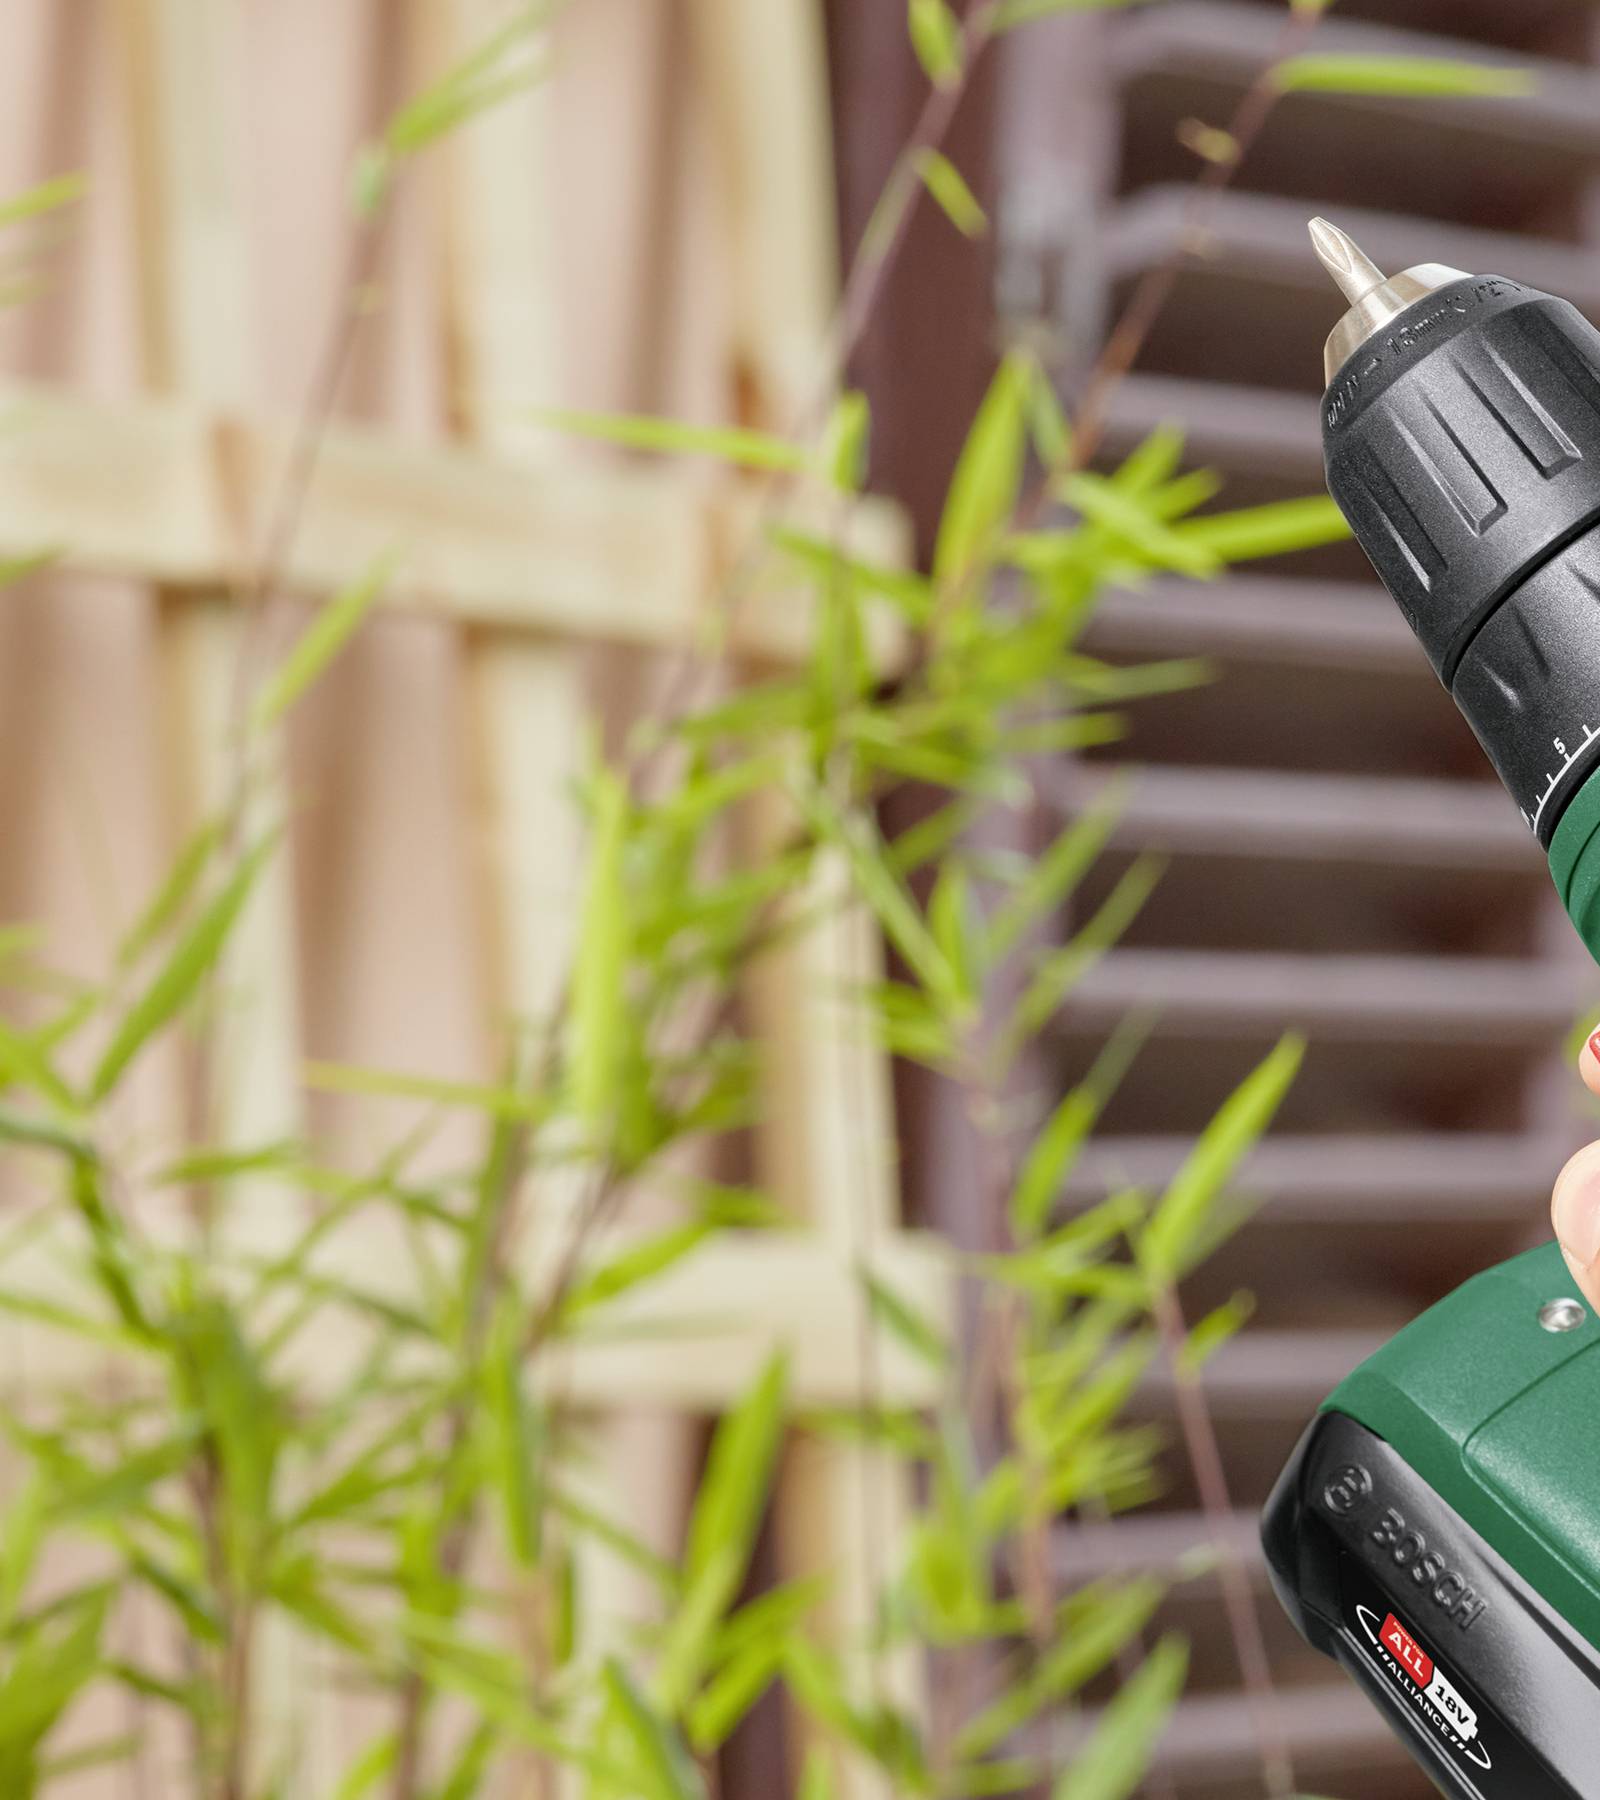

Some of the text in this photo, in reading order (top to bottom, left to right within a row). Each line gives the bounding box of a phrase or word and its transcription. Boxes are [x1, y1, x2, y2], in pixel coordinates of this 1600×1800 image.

[1553, 736, 1567, 755] 5
[1373, 1507, 1487, 1632] BOSCH
[1388, 1632, 1424, 1678] ALL
[1387, 1661, 1451, 1736] ALLIANCE
[1435, 1685, 1470, 1725] 18V
